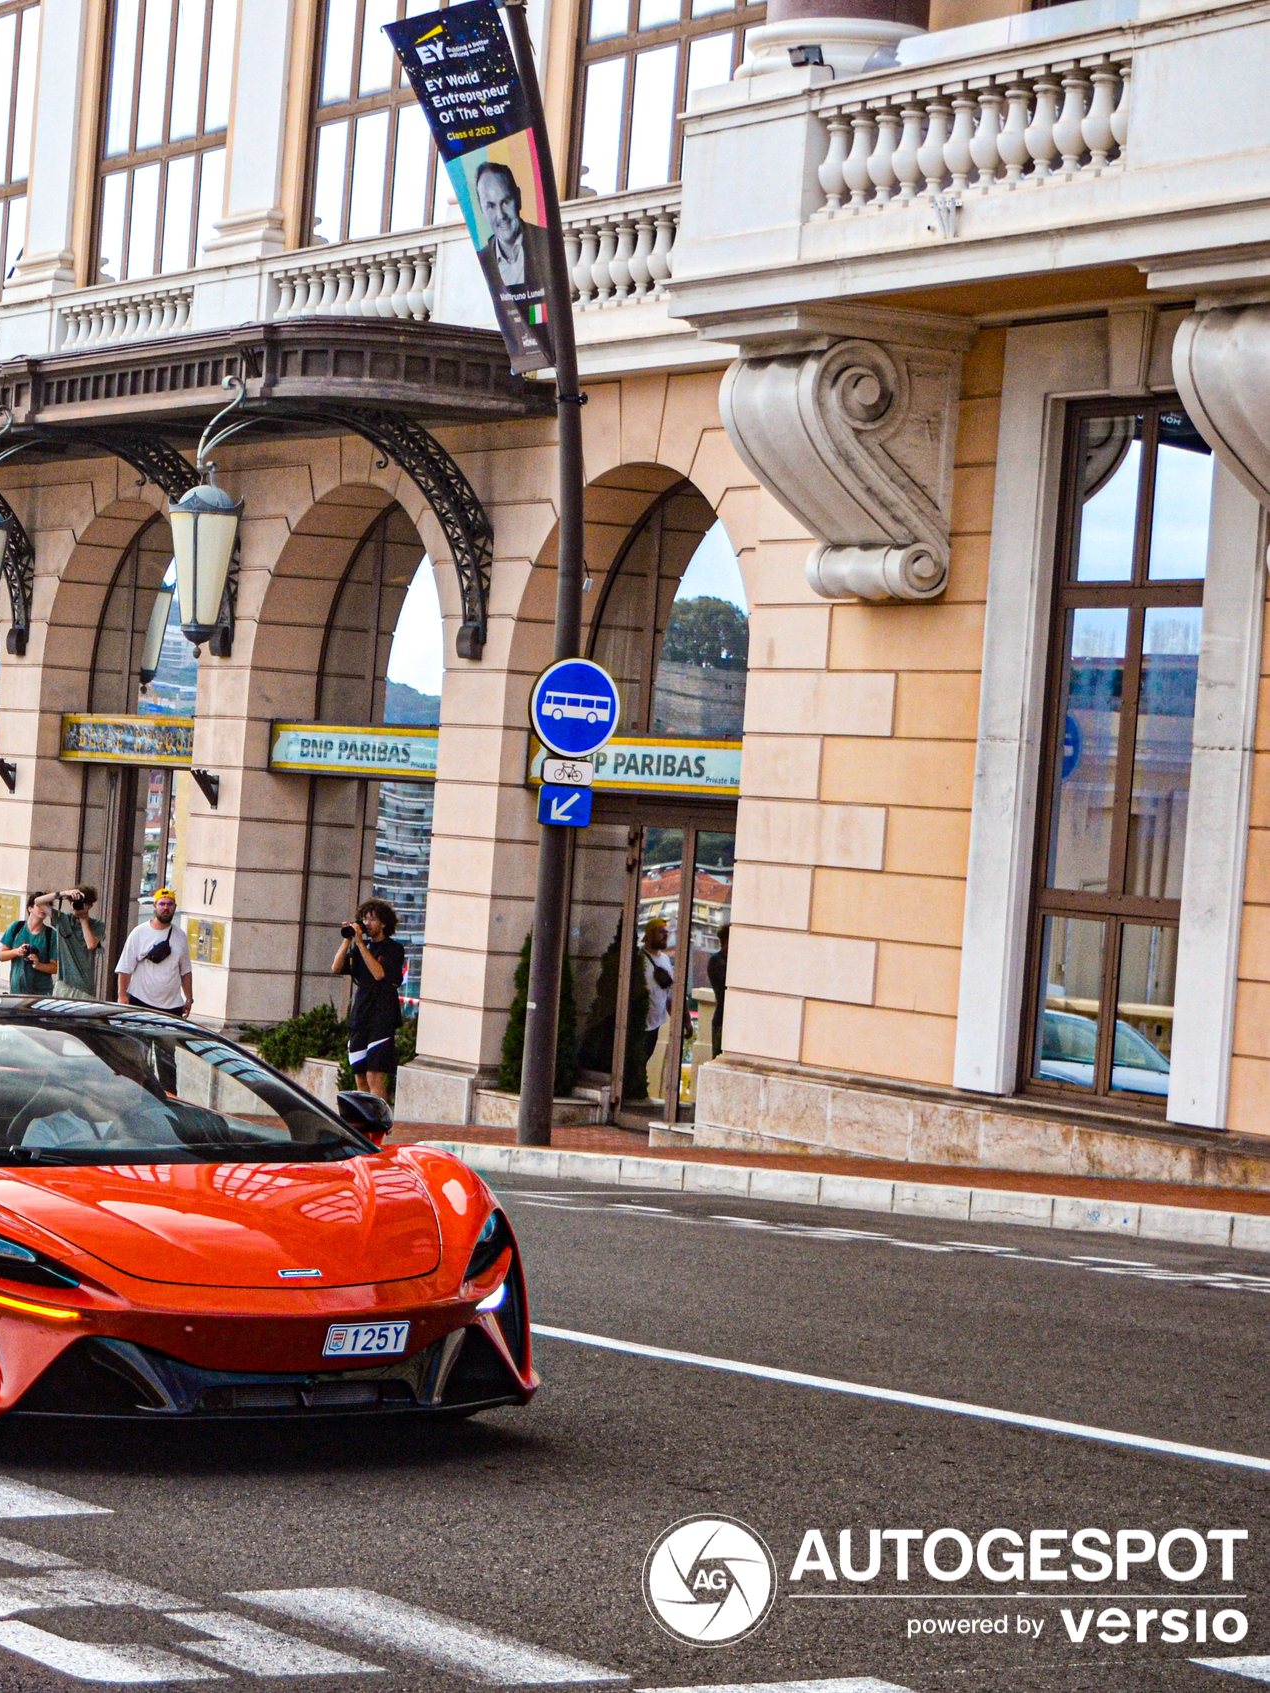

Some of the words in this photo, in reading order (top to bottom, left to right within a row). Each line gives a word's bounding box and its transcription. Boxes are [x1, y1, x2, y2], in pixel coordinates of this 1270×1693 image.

[415, 41, 445, 65] EY
[425, 77, 443, 93] EY
[446, 71, 480, 87] World
[432, 84, 509, 108] Entrepreneur
[439, 110, 455, 124] Of
[456, 106, 479, 120] The
[446, 130, 468, 141] Class
[475, 125, 497, 137] 2023
[300, 738, 334, 759] BNP
[337, 740, 411, 764] PARIBAS
[613, 752, 706, 778] PARIBAS
[705, 776, 728, 784] Private
[203, 878, 218, 906] 17
[351, 1325, 406, 1352] 125Y
